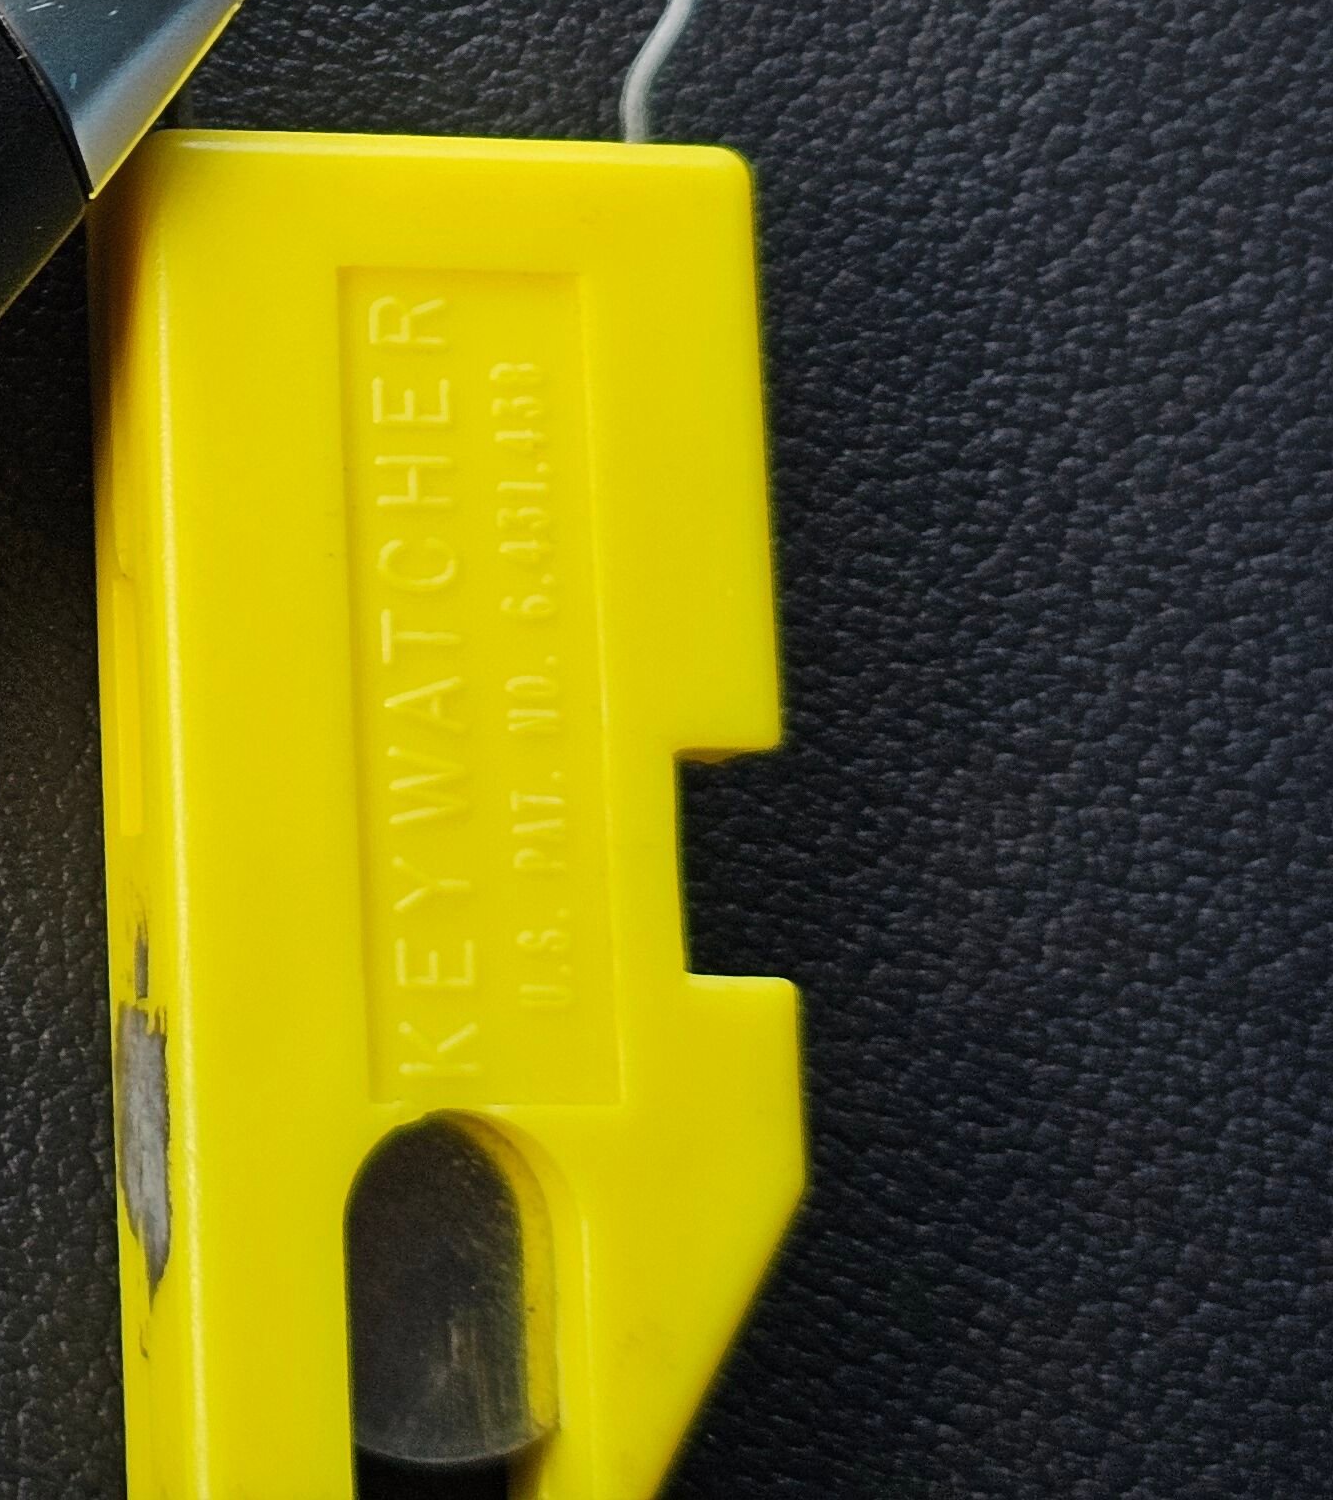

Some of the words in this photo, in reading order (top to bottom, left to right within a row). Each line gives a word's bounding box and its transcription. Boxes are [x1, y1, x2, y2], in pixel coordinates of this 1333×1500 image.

[368, 295, 481, 1076] KEYWATCHER
[510, 768, 566, 873] PAT.
[515, 907, 571, 1010] U.S.
